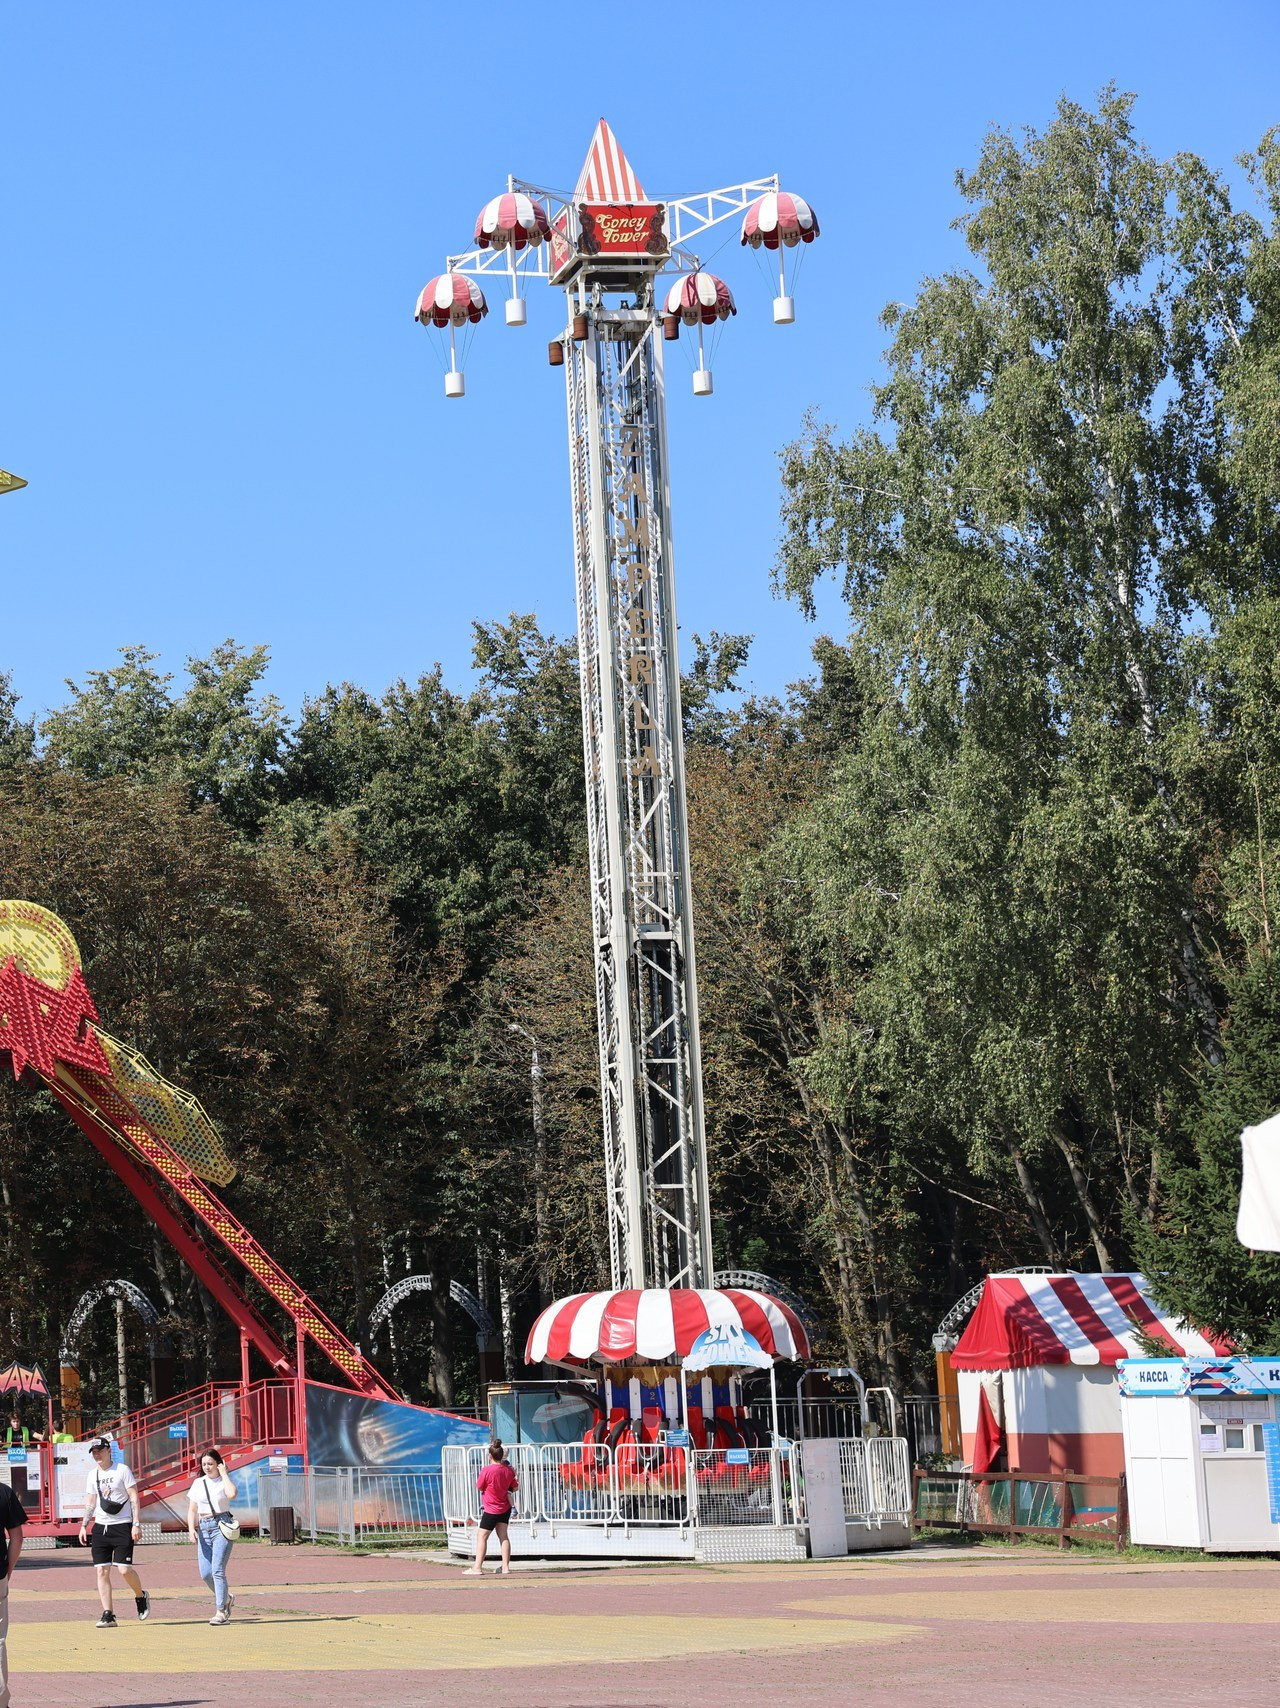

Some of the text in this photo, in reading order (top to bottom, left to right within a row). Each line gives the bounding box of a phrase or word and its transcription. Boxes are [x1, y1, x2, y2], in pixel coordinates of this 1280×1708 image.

[603, 228, 650, 243] Tower
[704, 1323, 747, 1345] SKY
[698, 1342, 756, 1364] TOWER
[1139, 1371, 1169, 1383] КАССА
[649, 1391, 656, 1400] 2
